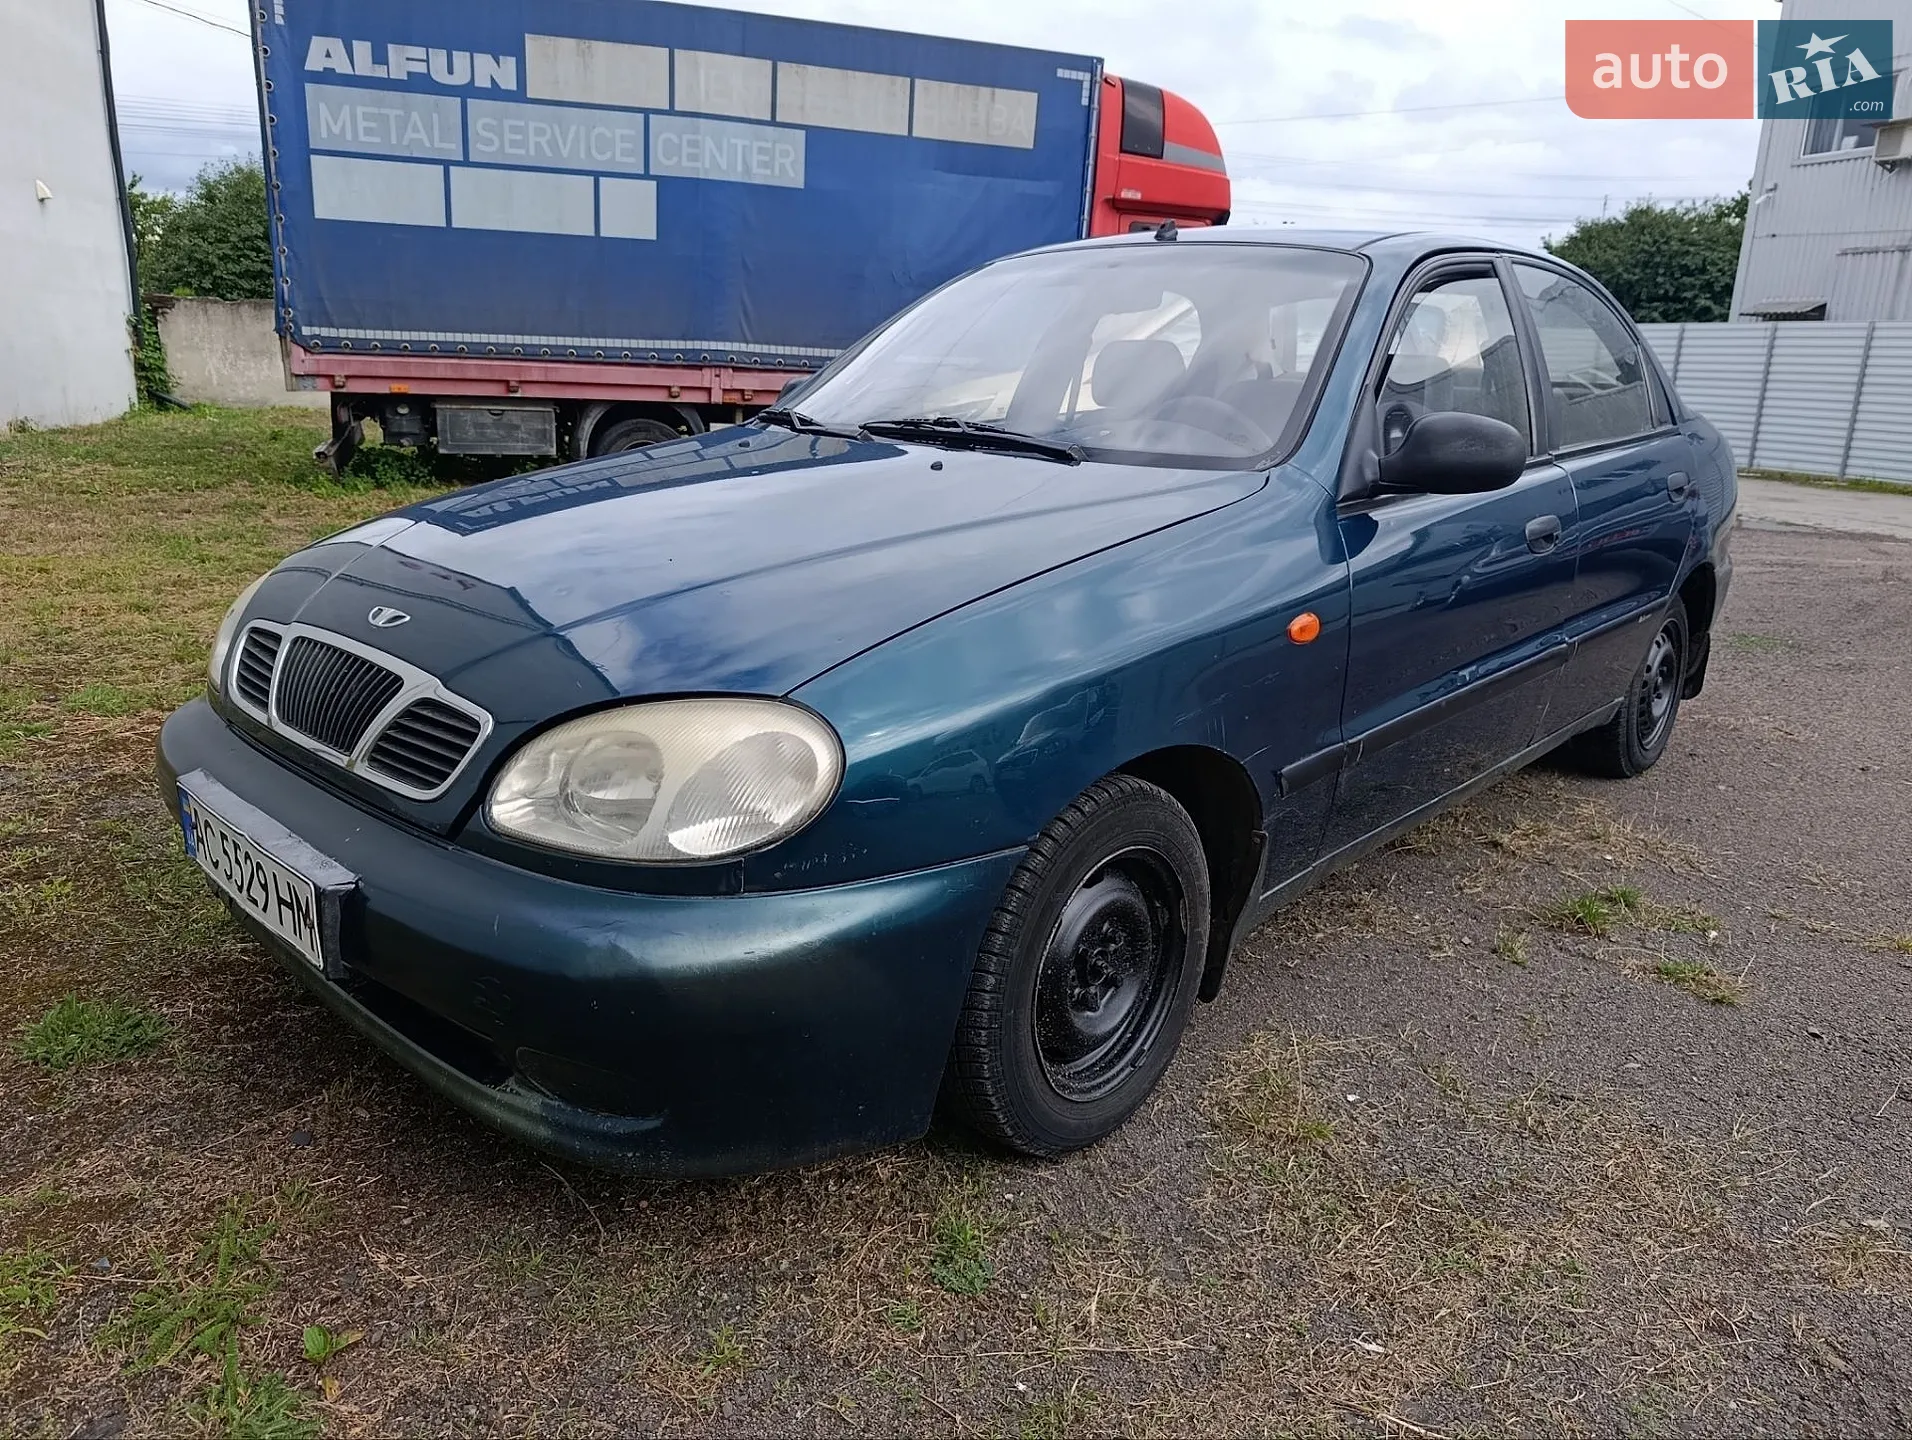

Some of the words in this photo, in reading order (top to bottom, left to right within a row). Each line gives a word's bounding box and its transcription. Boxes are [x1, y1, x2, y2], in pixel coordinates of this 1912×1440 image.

[304, 35, 517, 91] ALFUN
[319, 102, 457, 151] METAL
[475, 117, 636, 164] SERVICE
[656, 132, 796, 178] CENTER
[193, 807, 220, 870] AC
[219, 830, 270, 914] 5529
[272, 871, 316, 952] HM
